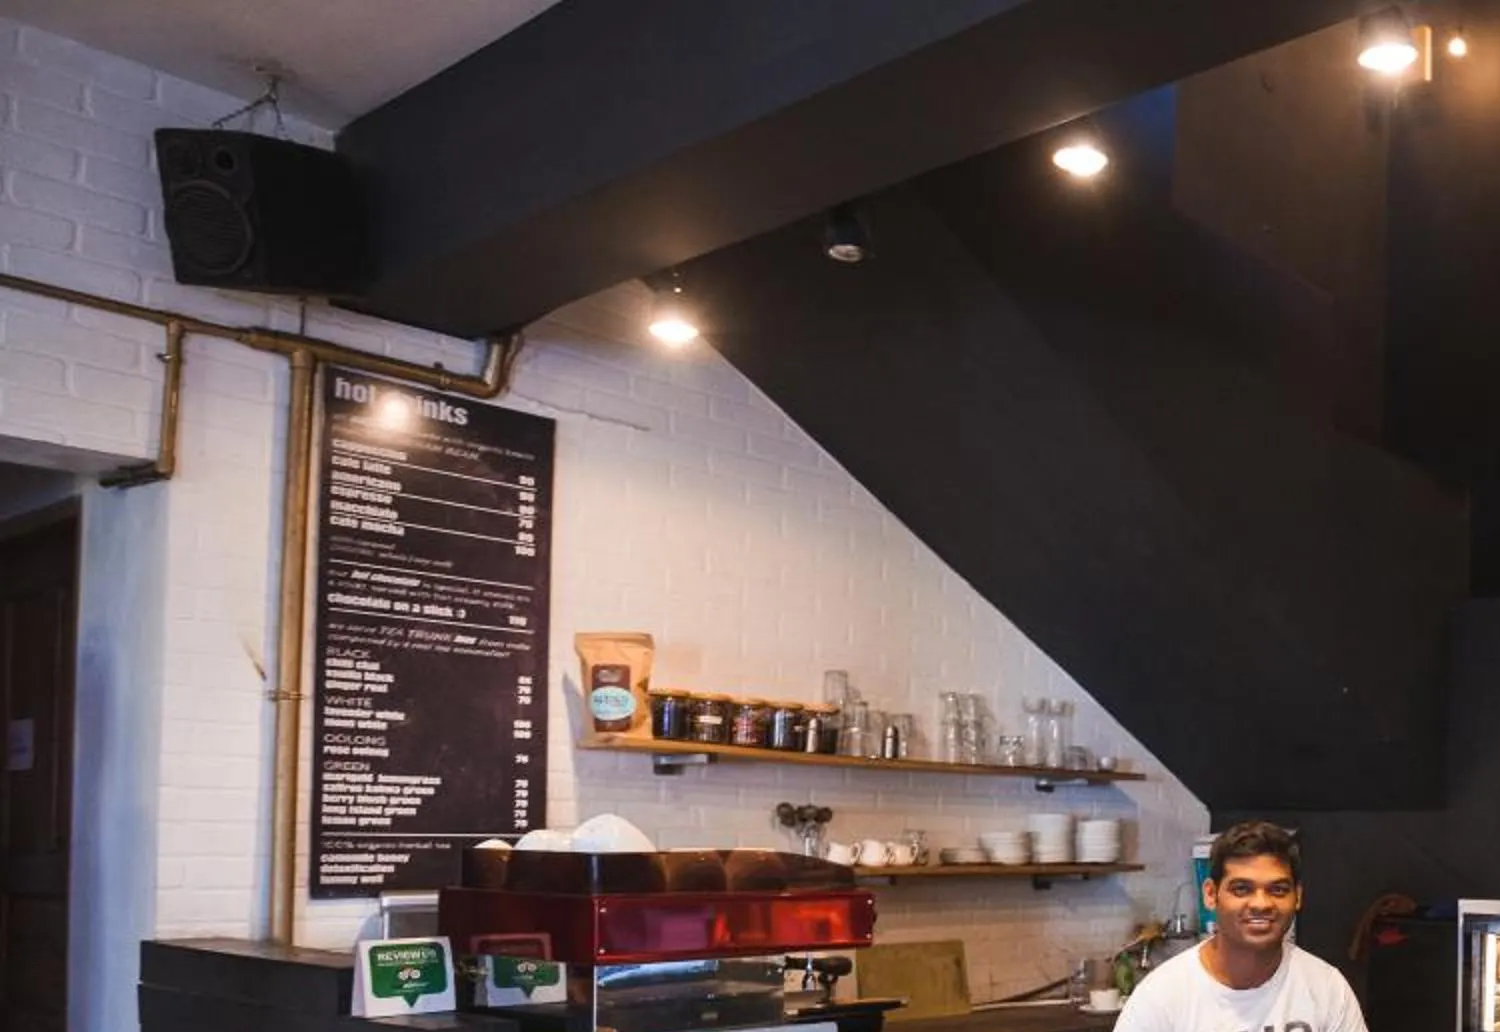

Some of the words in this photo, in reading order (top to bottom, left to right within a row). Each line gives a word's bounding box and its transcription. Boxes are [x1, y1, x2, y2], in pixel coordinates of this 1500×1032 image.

[327, 593, 391, 611] chocolate
[393, 600, 410, 613] on
[411, 602, 421, 614] a
[422, 604, 453, 618] stick
[407, 628, 452, 642] TRUNK
[326, 645, 371, 659] BLACK
[325, 695, 373, 708] WHITE
[323, 733, 387, 747] OOLONG
[323, 760, 371, 771] GREEN
[384, 806, 417, 817] green
[357, 817, 392, 827] green
[377, 948, 420, 962] REVIEW
